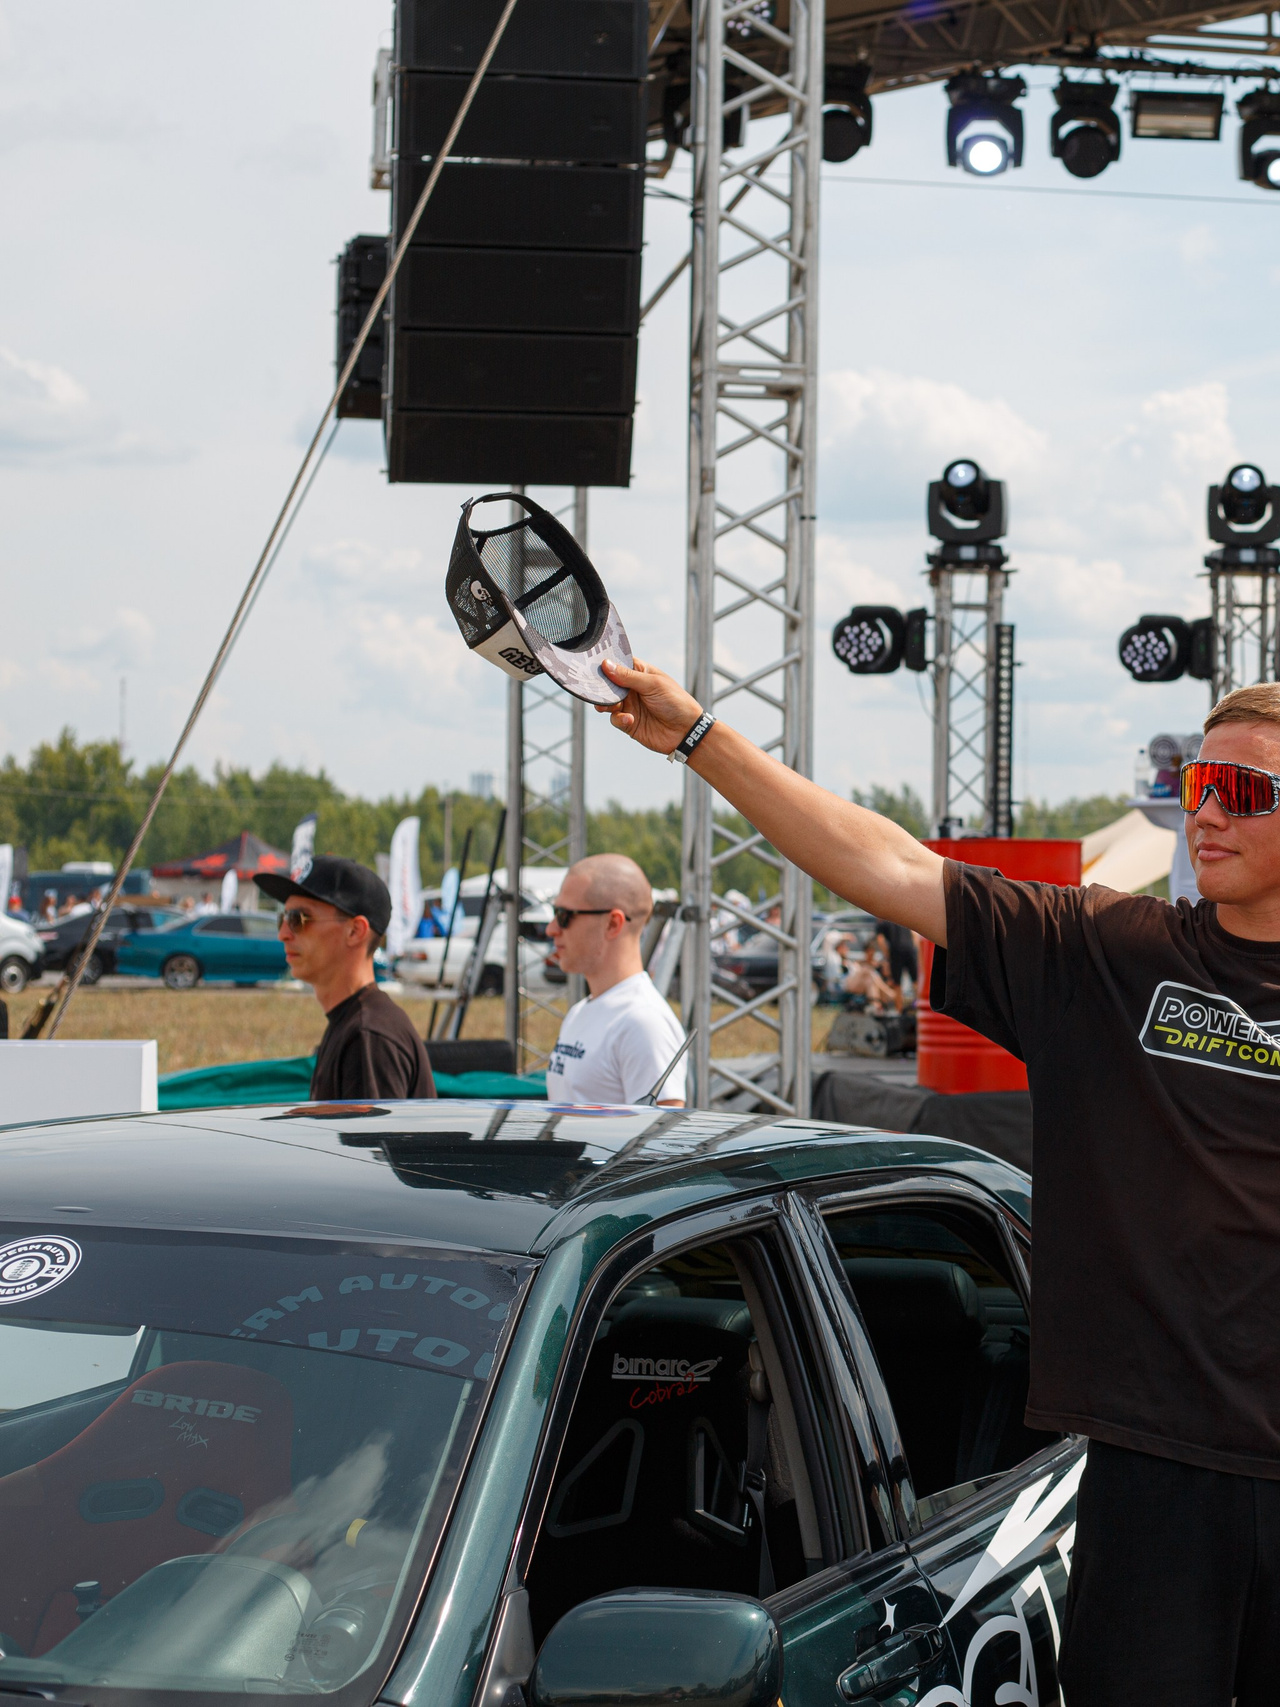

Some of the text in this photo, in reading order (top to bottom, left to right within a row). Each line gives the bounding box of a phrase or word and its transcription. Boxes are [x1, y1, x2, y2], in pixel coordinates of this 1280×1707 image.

[685, 716, 712, 748] PERM
[41, 1244, 66, 1264] AUTO
[44, 1267, 65, 1275] 24
[131, 1389, 263, 1424] BRIDE
